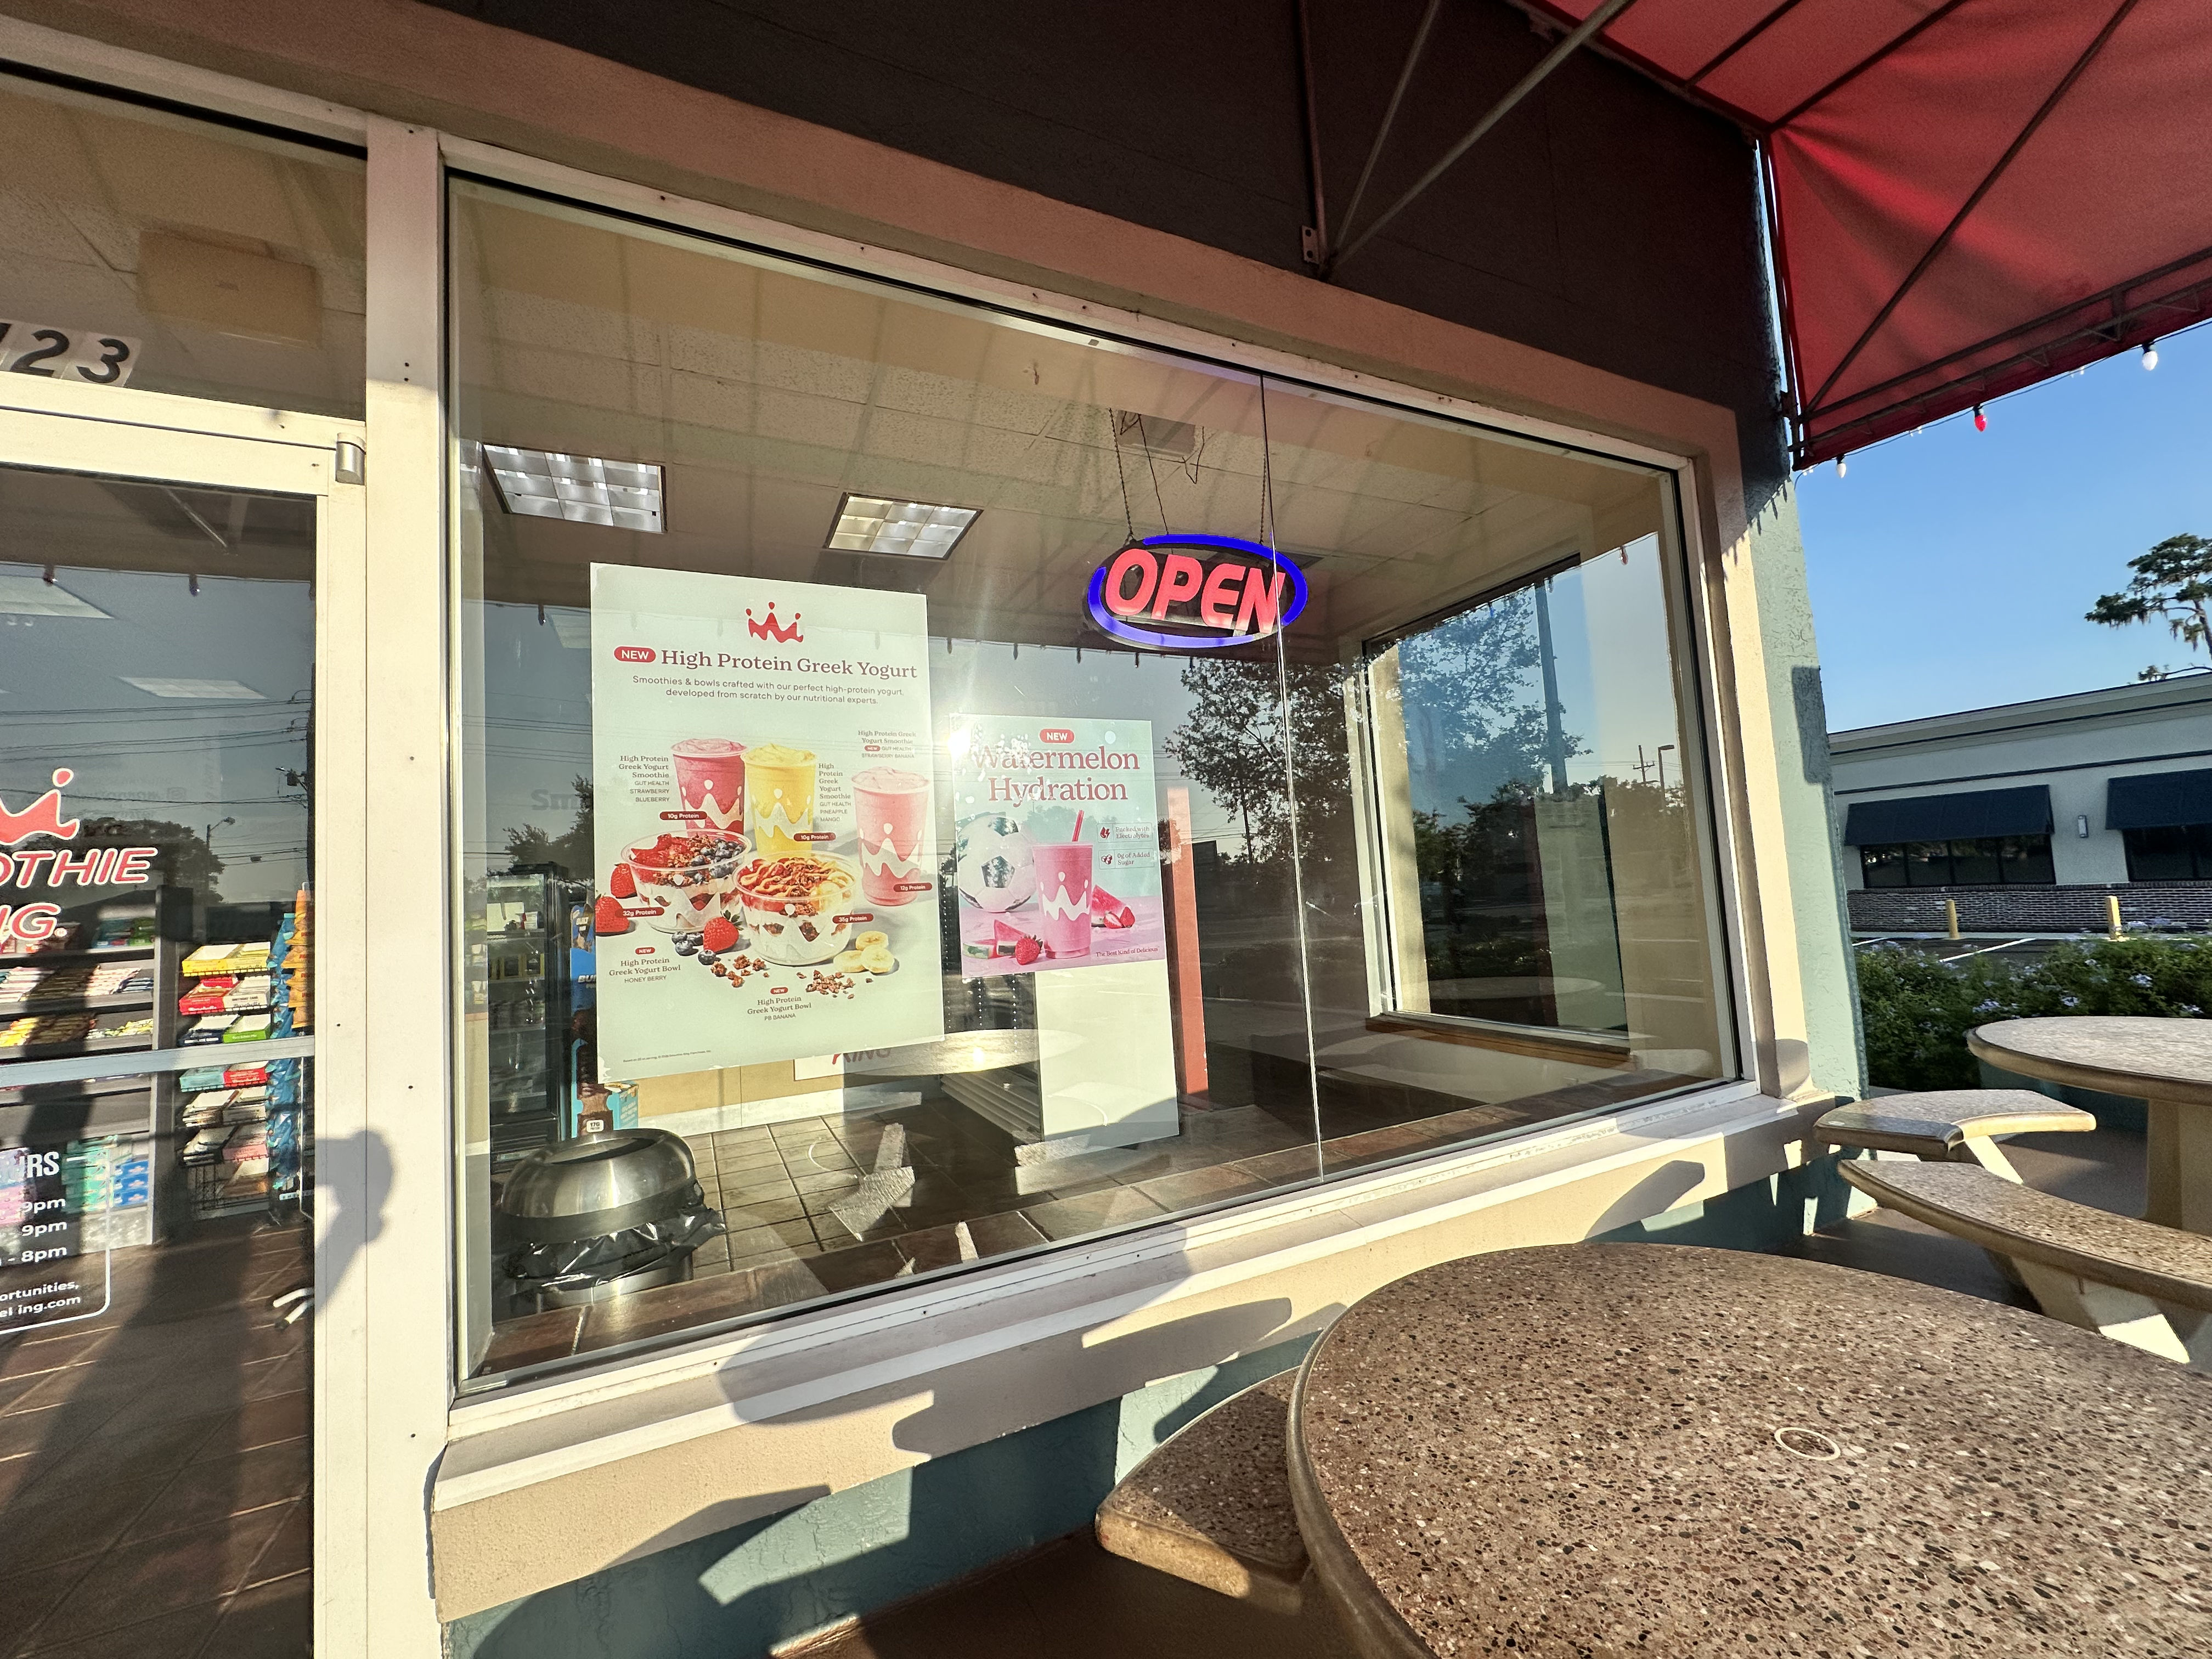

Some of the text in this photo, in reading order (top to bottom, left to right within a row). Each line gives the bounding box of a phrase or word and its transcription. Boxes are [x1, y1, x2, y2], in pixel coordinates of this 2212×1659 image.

[1105, 548, 1286, 634] OPEN
[621, 650, 918, 680] NEW High Protein Greek Yogurt
[633, 675, 682, 686] Smoothies
[685, 678, 691, 686] &
[694, 678, 720, 687] bowls
[722, 680, 754, 689] crafted
[793, 684, 823, 692] perfect
[826, 685, 876, 694] high-protein
[665, 689, 715, 698] developed
[775, 693, 785, 702] by
[847, 696, 879, 705] experts.
[1046, 731, 1068, 741] NEW
[988, 776, 1128, 808] Hydration
[620, 959, 640, 967] High
[634, 967, 661, 975] Yogurt
[757, 996, 802, 1006] High Protein
[770, 1005, 793, 1013] Yogurt
[22, 1198, 66, 1214] 9pm
[21, 1221, 67, 1237] 9pm
[21, 1246, 67, 1263] 8pm
[0, 1280, 80, 1302] ortunities,
